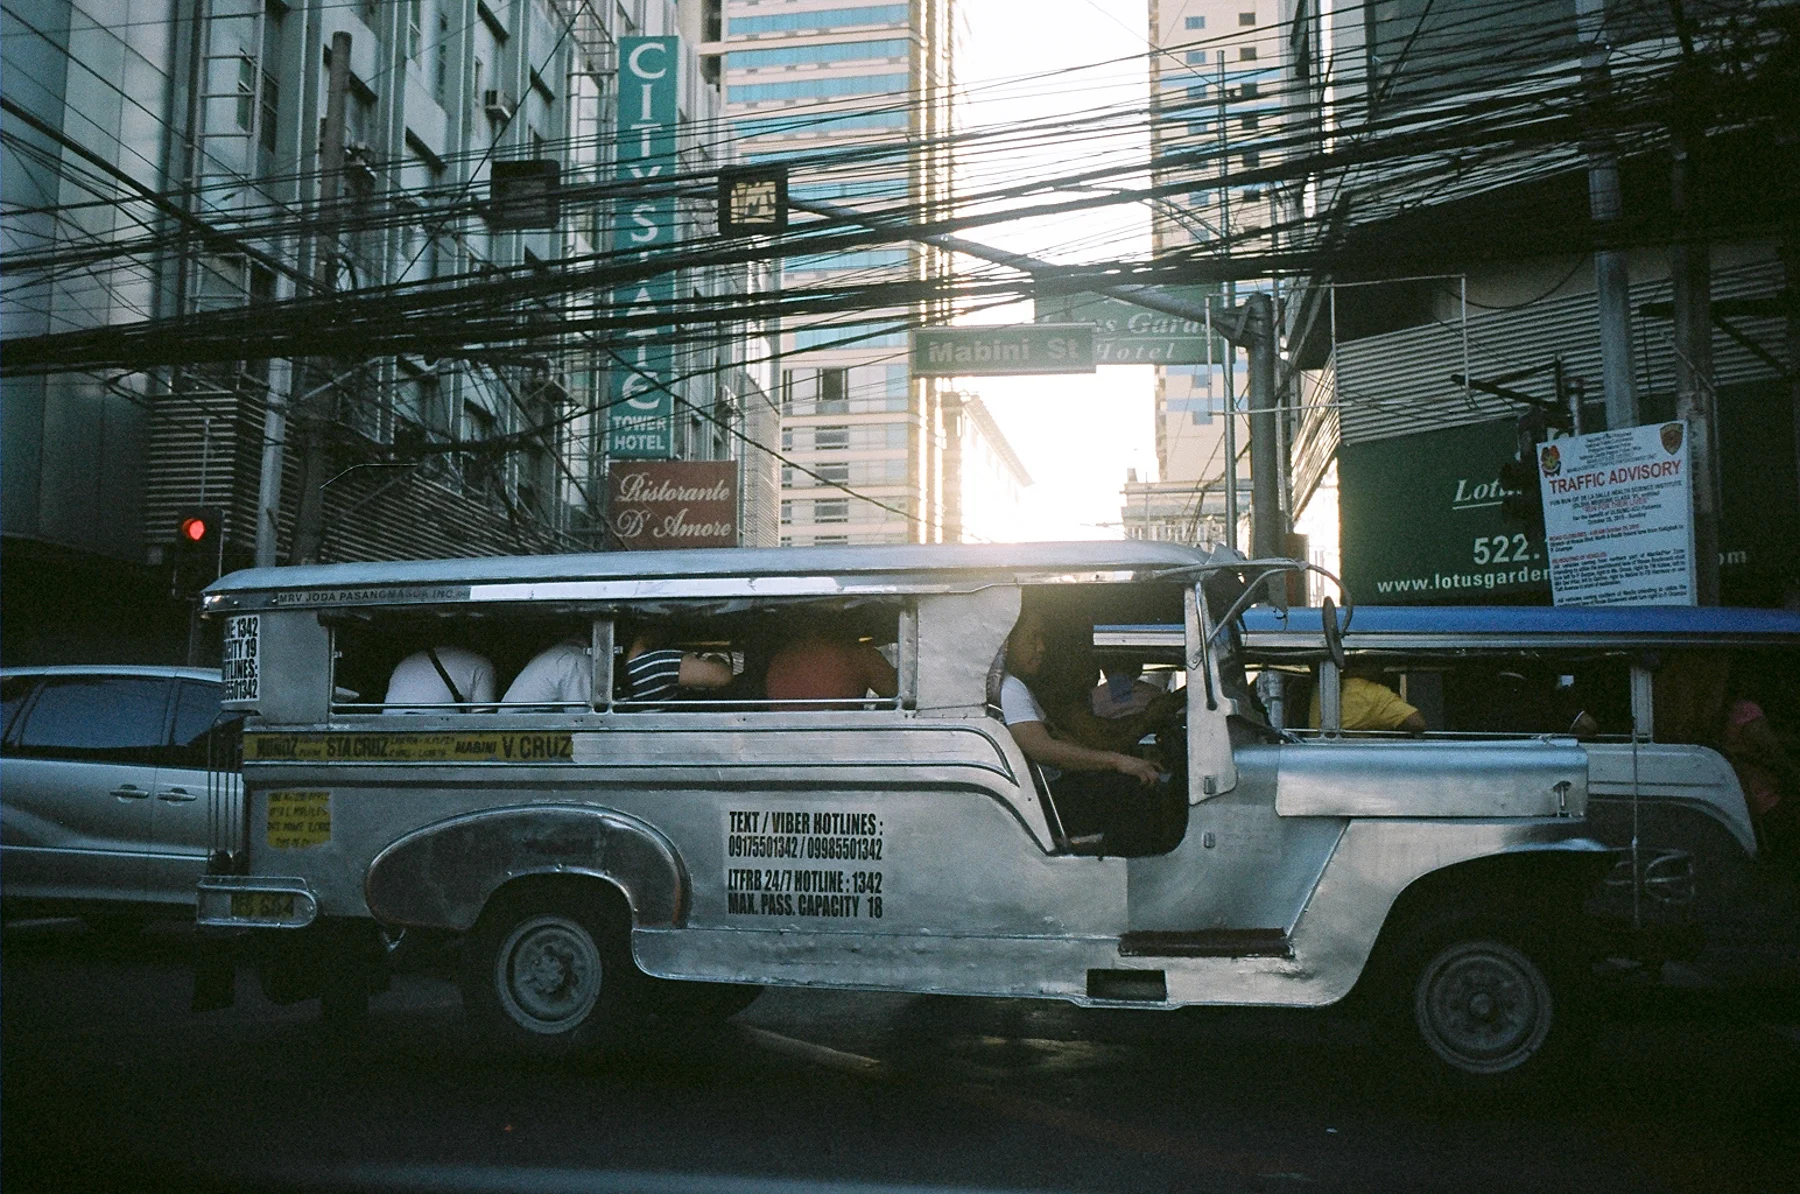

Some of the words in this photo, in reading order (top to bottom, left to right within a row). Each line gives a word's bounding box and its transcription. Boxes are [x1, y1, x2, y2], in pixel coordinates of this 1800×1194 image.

[928, 338, 1029, 364] Mabini
[1046, 337, 1078, 361] St
[612, 415, 667, 431] TOWER
[614, 434, 666, 450] HOTEL
[615, 472, 730, 501] Ristorante
[1549, 470, 1605, 494] TRAFFIC
[1608, 459, 1682, 485] ADVISORY
[653, 508, 732, 538] Amore
[237, 616, 258, 637] 1342
[245, 638, 257, 657] 19
[519, 735, 572, 759] CRUZ
[729, 811, 760, 833] TEXT
[772, 812, 810, 834] VIBER
[813, 813, 876, 836] HOTLINES
[728, 835, 798, 859] 09175501342
[807, 837, 883, 860] 09985501342
[728, 868, 762, 891] LTFRB
[764, 869, 792, 892] 24/7
[794, 870, 843, 893] HOTLINE
[852, 871, 883, 894] 1342
[728, 893, 758, 915] MAX.
[761, 893, 795, 916] PASS.
[798, 894, 860, 918] CAPACITY
[867, 896, 883, 919] 18
